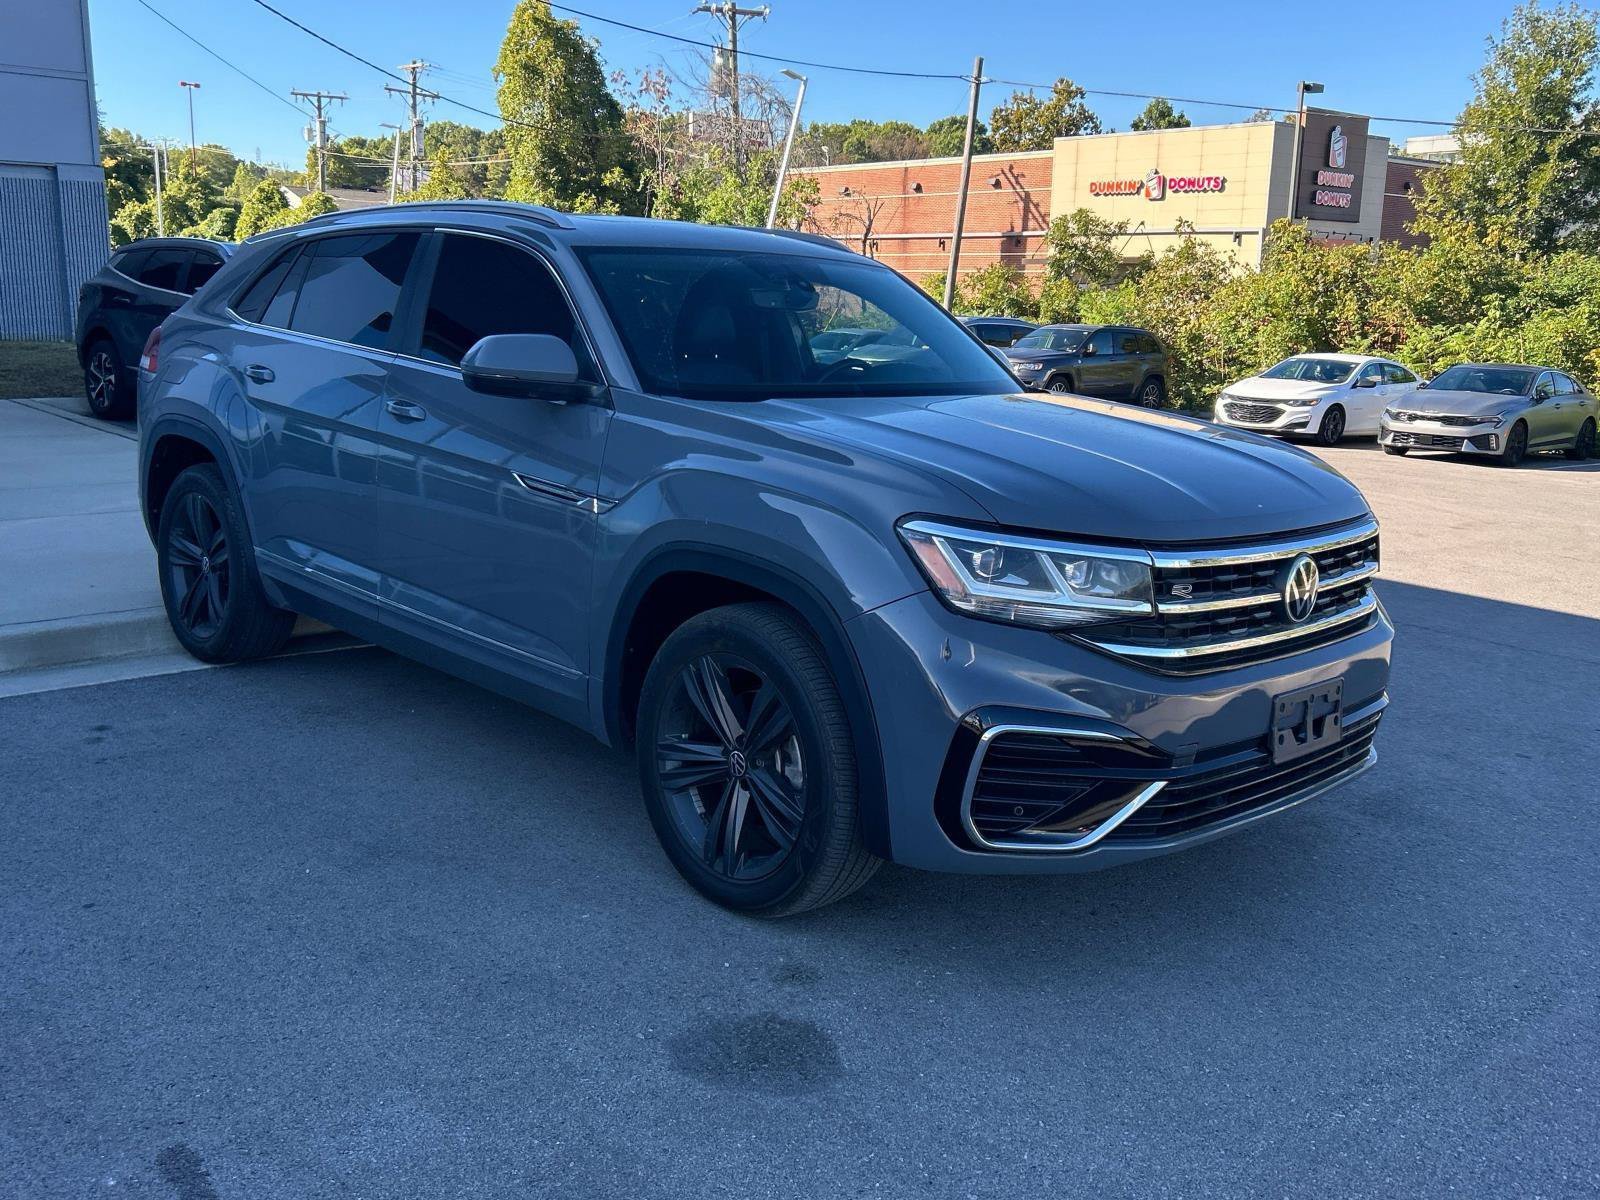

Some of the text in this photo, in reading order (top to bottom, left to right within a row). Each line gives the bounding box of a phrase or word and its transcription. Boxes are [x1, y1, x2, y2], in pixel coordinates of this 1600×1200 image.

[1089, 176, 1222, 194] DUNKIN' DONUTS
[1315, 190, 1352, 208] DONUTS
